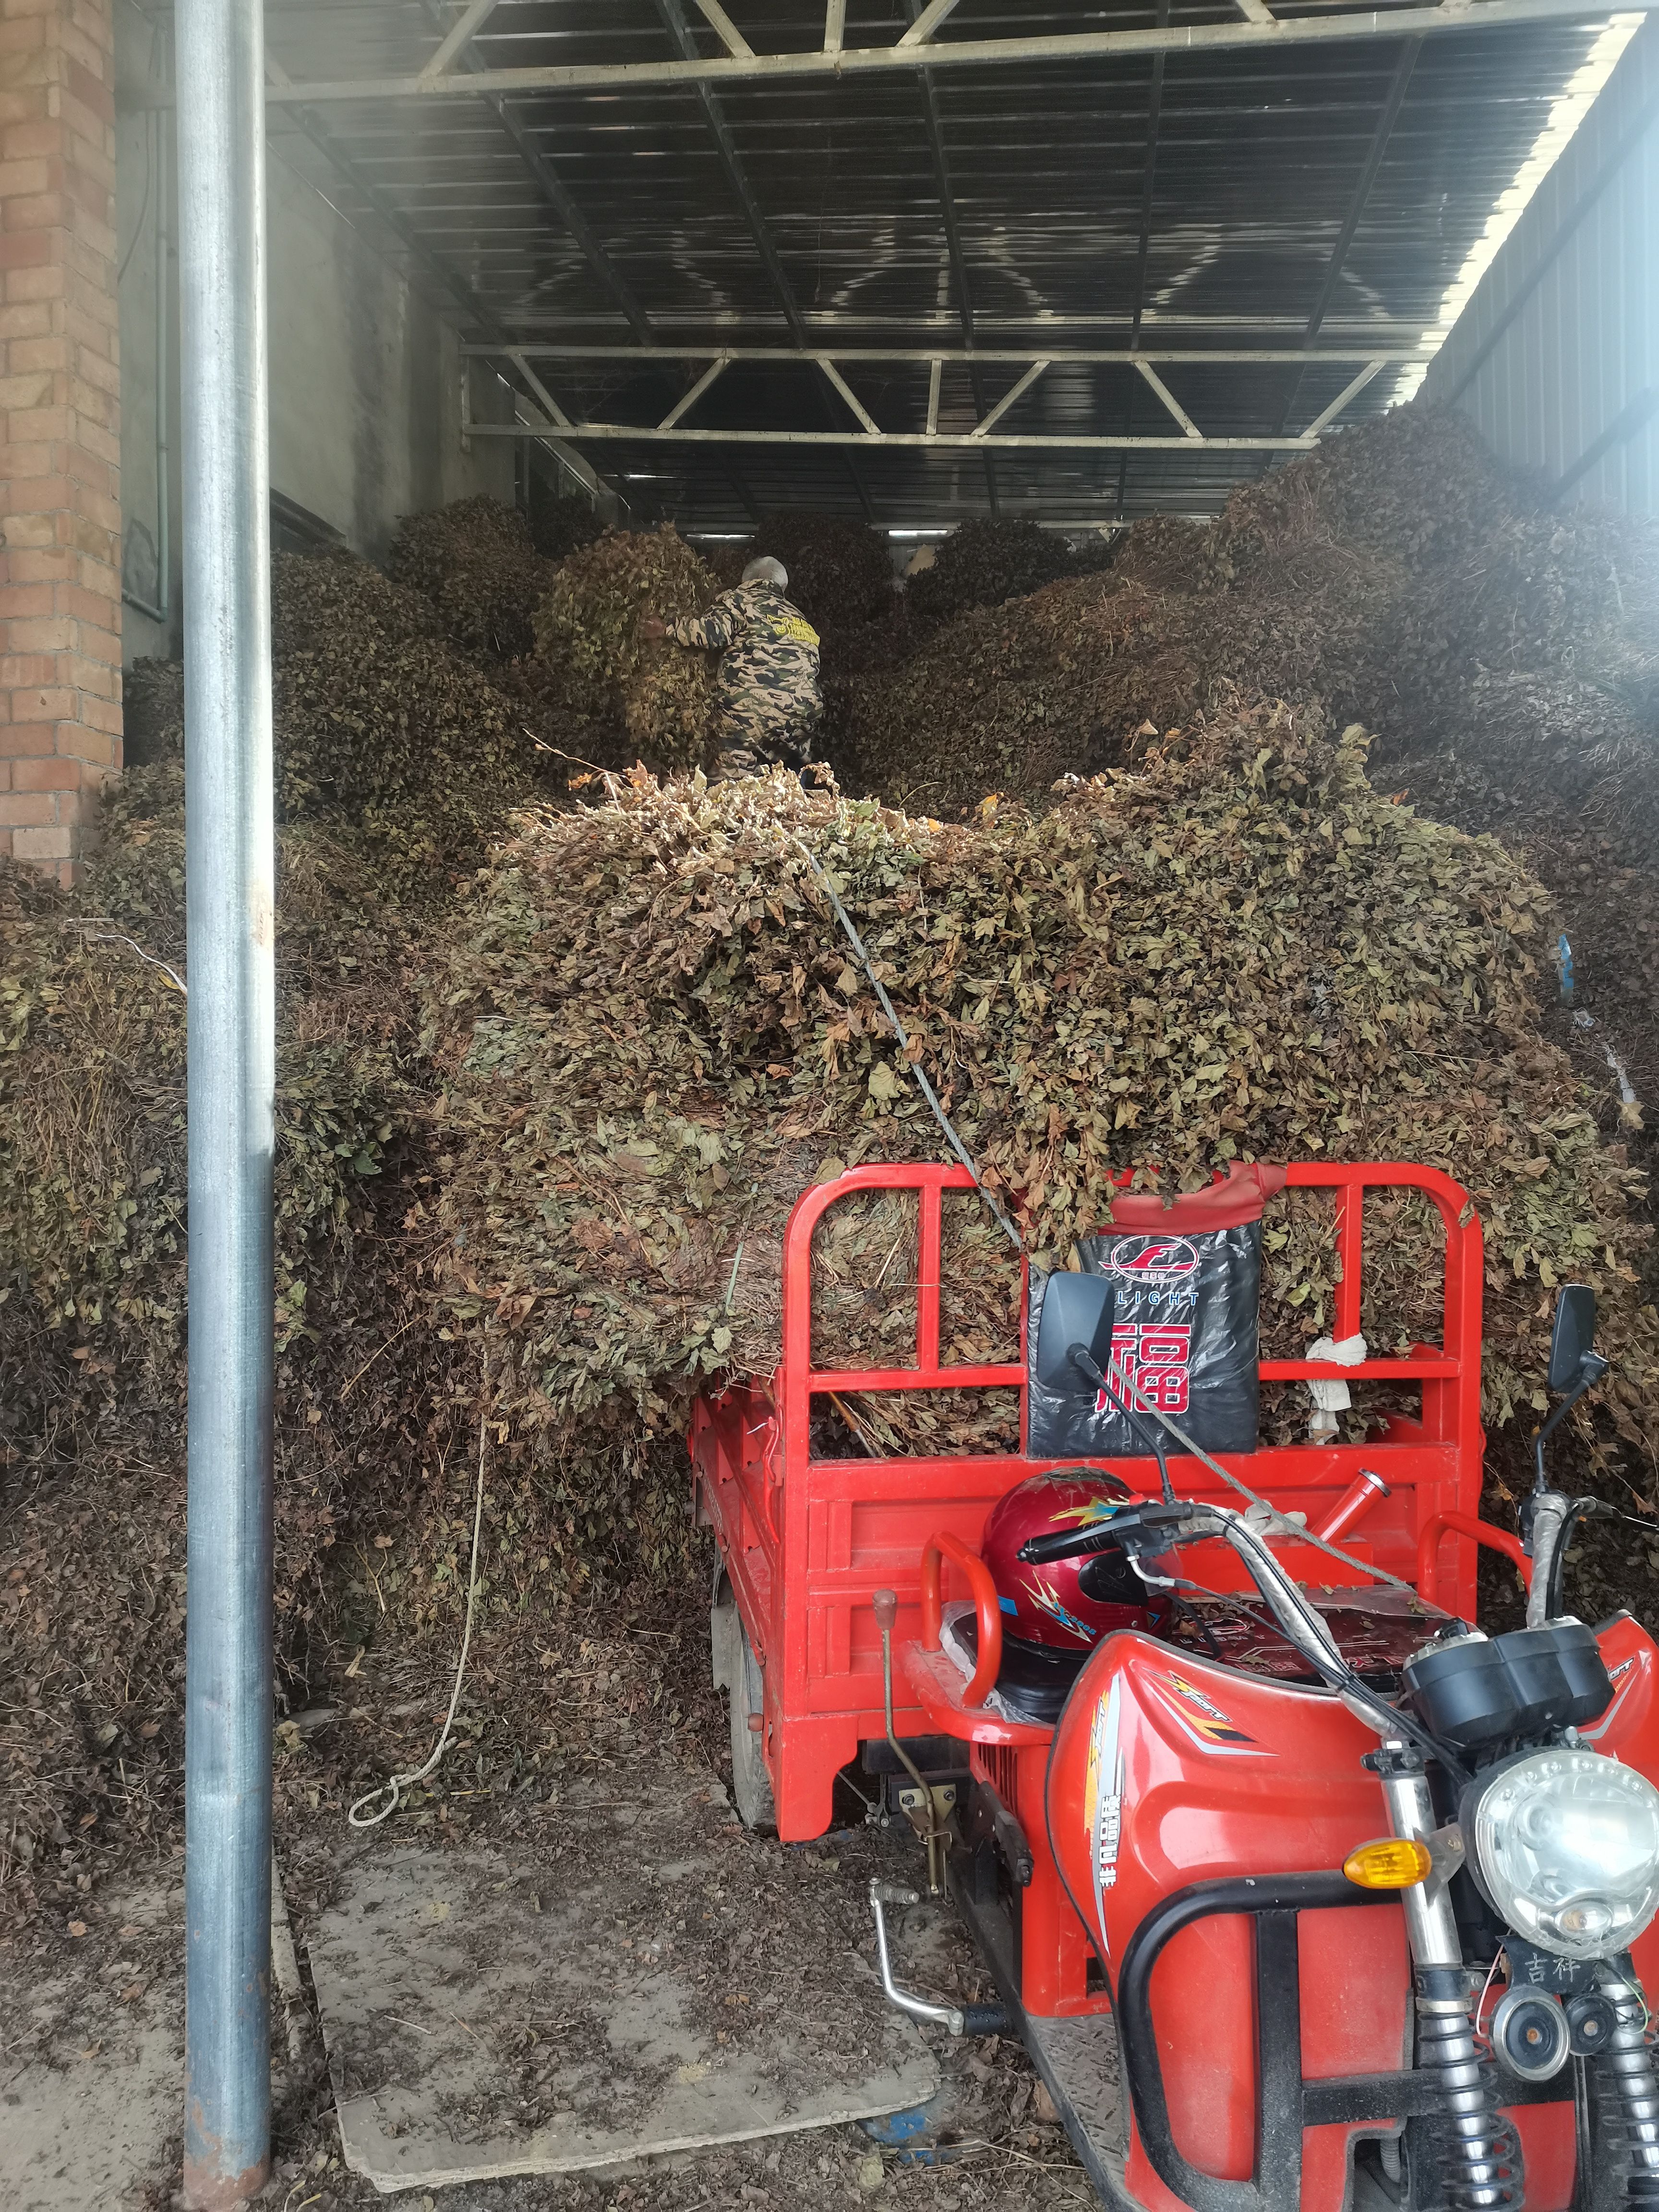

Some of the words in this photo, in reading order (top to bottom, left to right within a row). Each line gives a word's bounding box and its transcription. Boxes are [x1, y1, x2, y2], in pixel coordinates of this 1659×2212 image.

[1118, 1291, 1199, 1305] LIGHT
[1094, 1323, 1191, 1413] 福
[1099, 1794, 1121, 1887] 非凡品质
[1525, 1953, 1580, 1984] 吉祥
